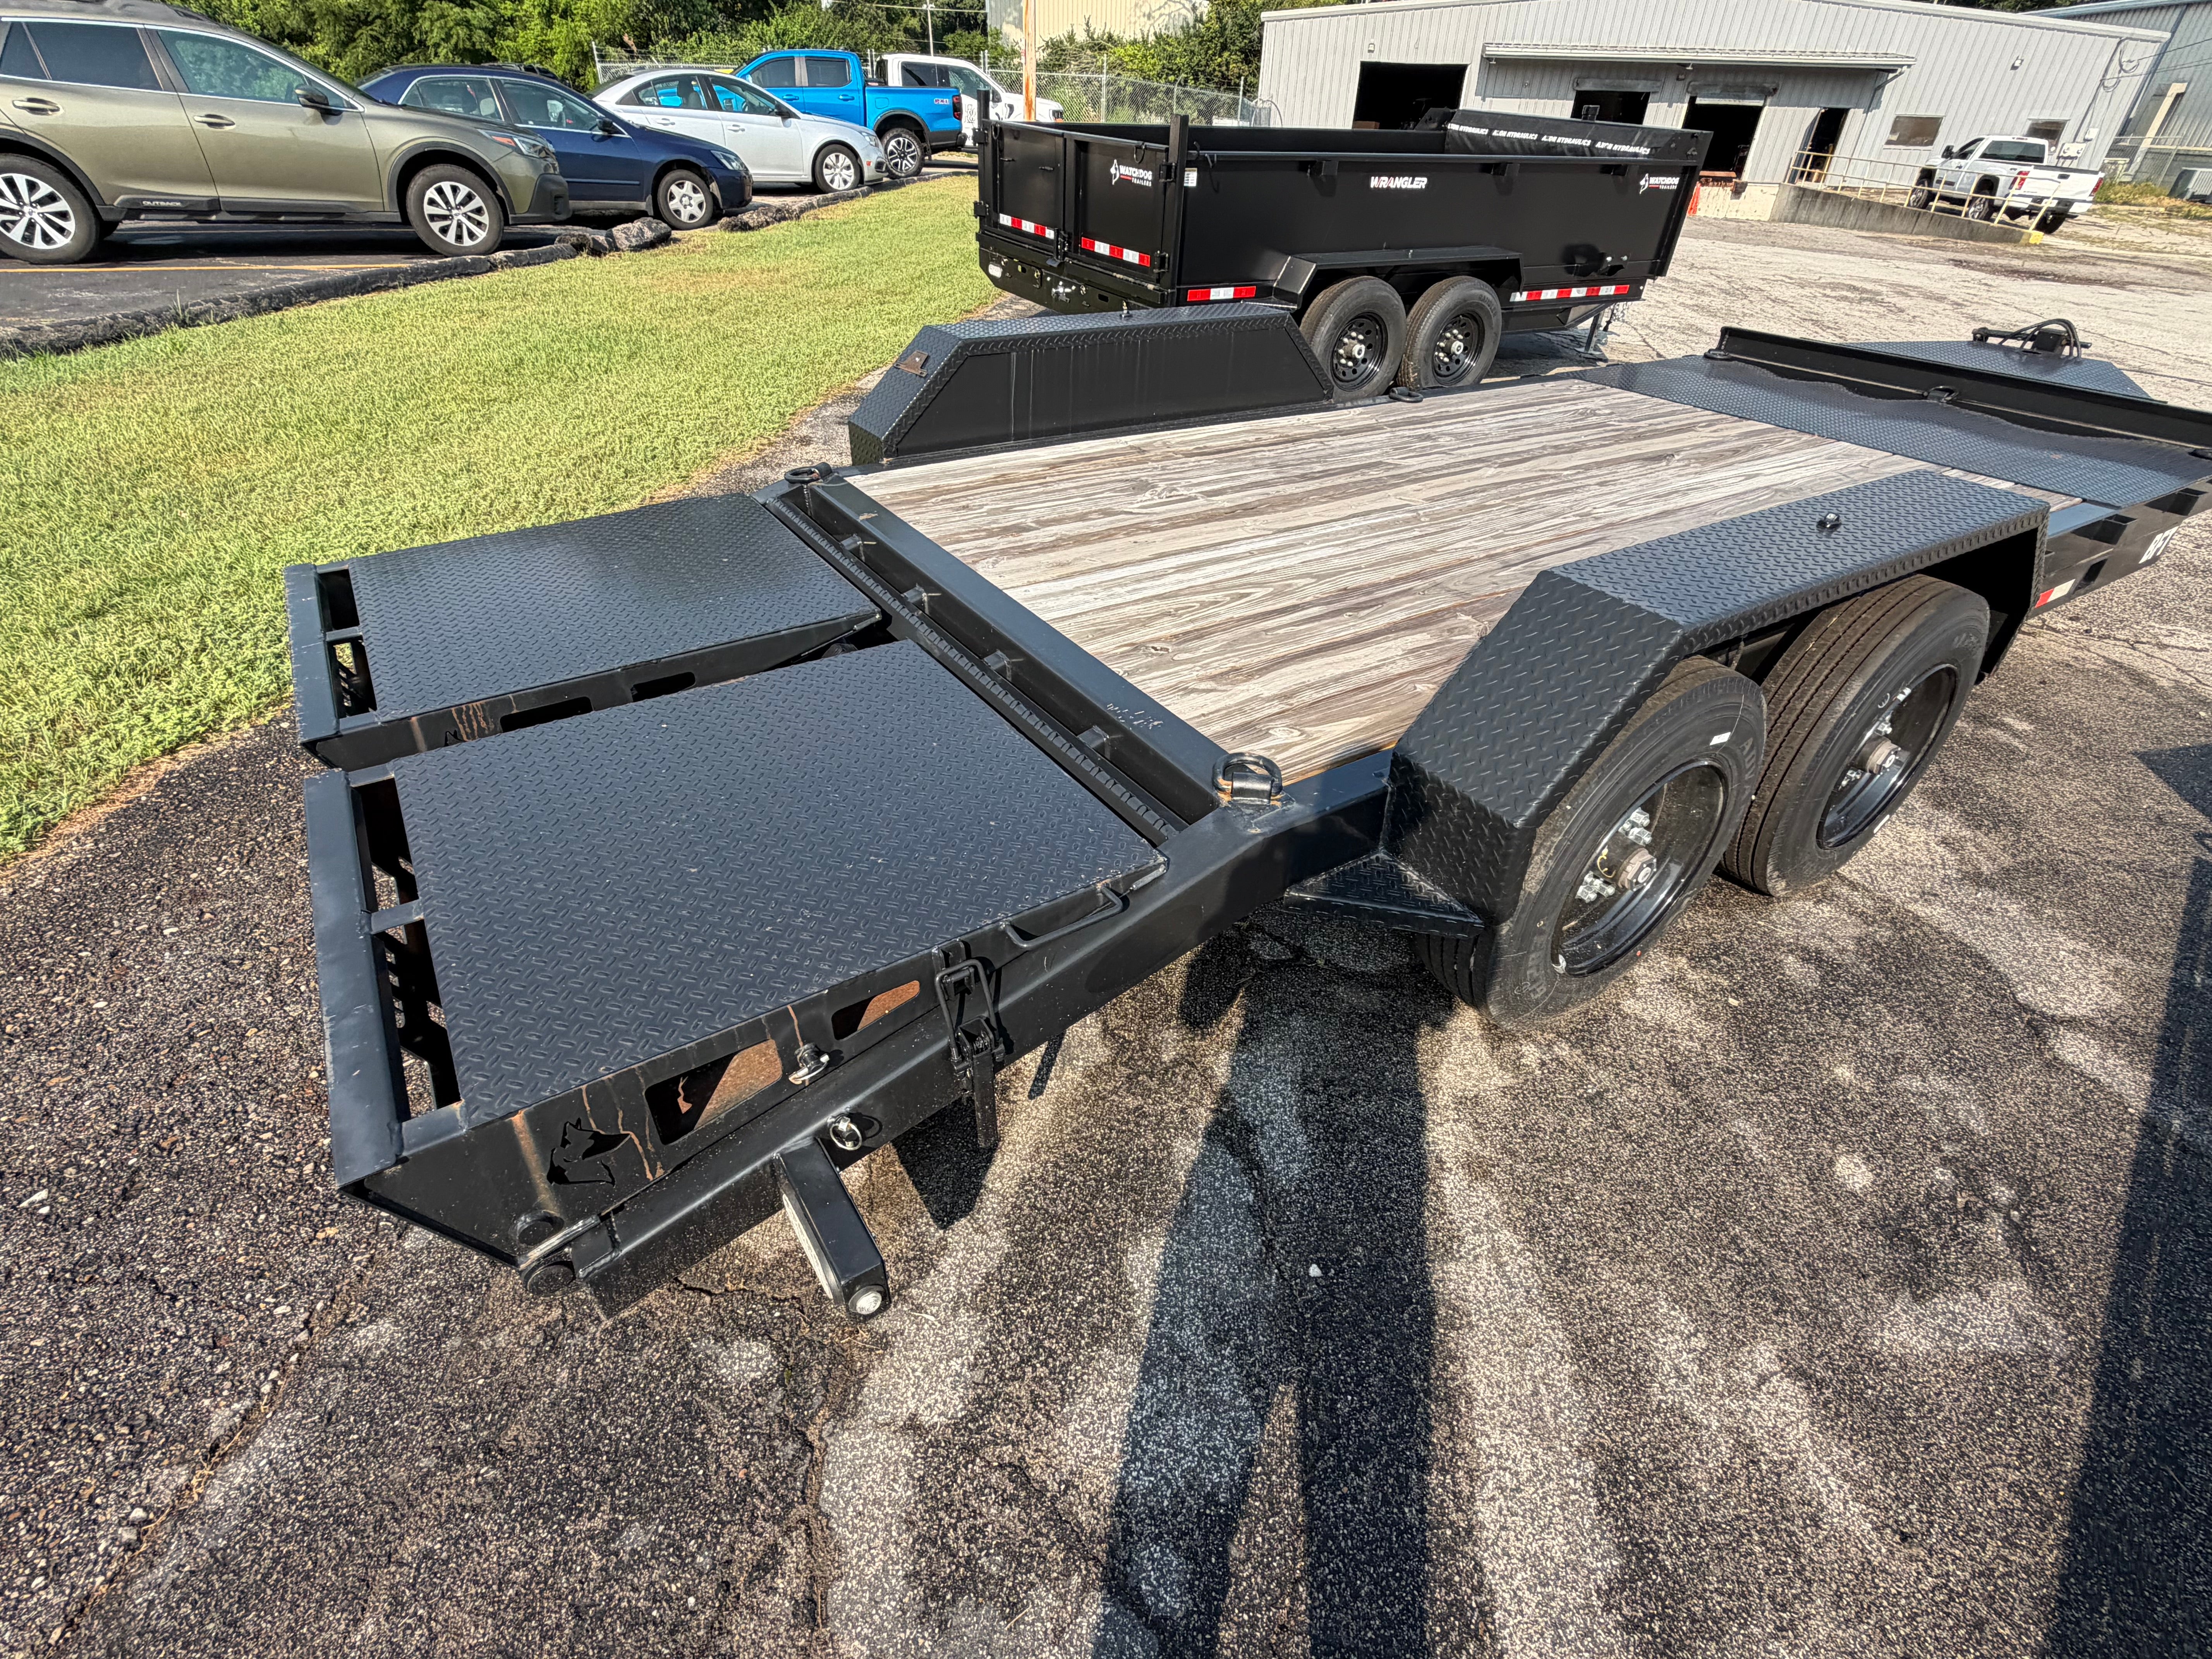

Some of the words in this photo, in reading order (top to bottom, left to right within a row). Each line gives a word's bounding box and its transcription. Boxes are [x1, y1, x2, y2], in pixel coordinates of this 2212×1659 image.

[1506, 131, 1538, 140] HYDRAULICS
[1556, 136, 1592, 146] HYDRAULICS
[1613, 144, 1651, 155] HYDRAULICS
[1119, 165, 1152, 180] WATCHDOG
[1132, 177, 1152, 187] TRAILERS
[1370, 176, 1428, 189] WRANGLER
